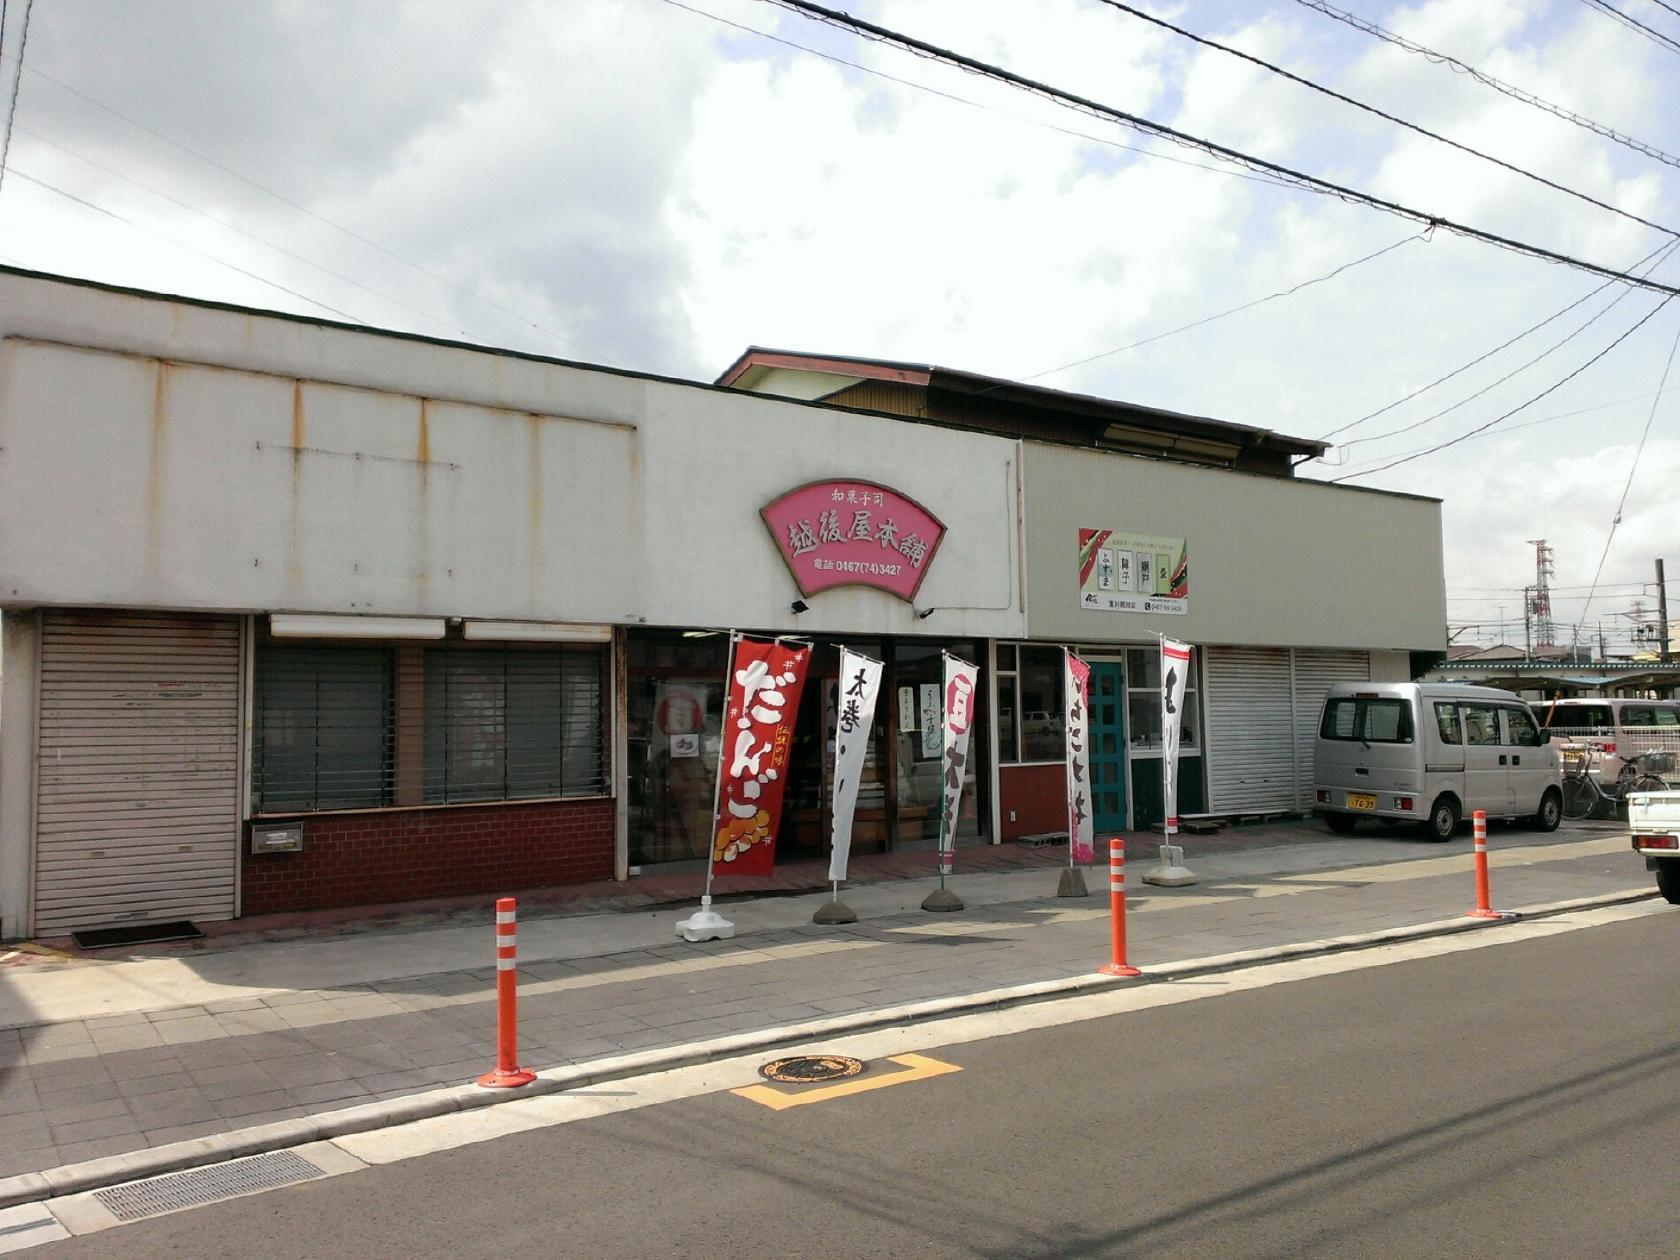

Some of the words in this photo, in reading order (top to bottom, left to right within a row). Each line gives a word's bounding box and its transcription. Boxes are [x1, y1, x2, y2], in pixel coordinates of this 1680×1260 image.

[831, 488, 884, 508] 和菓子司
[727, 659, 798, 819] だんご
